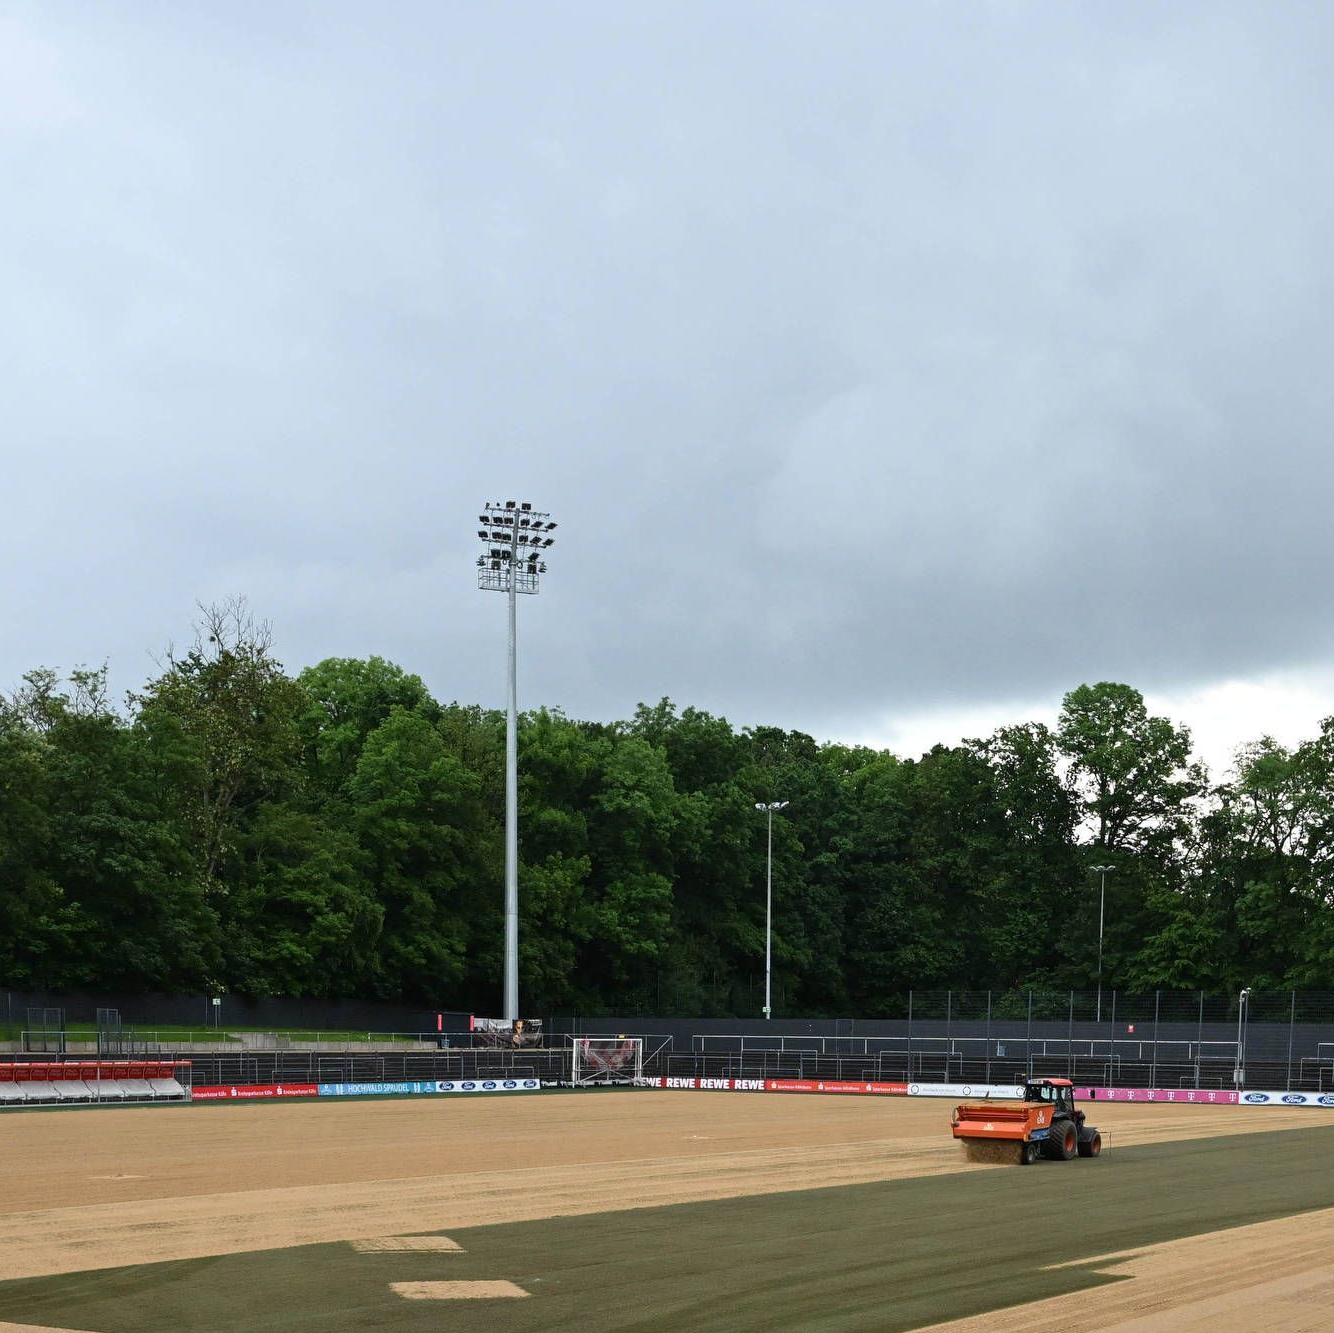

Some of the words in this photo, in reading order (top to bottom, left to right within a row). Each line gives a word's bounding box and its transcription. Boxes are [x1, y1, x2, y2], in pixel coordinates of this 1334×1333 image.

[347, 1084, 383, 1093] HOCHWALD
[384, 1083, 410, 1092] SPRUDEL
[667, 1078, 695, 1088] REWE
[700, 1078, 730, 1089] REWE
[734, 1079, 764, 1090] REWE
